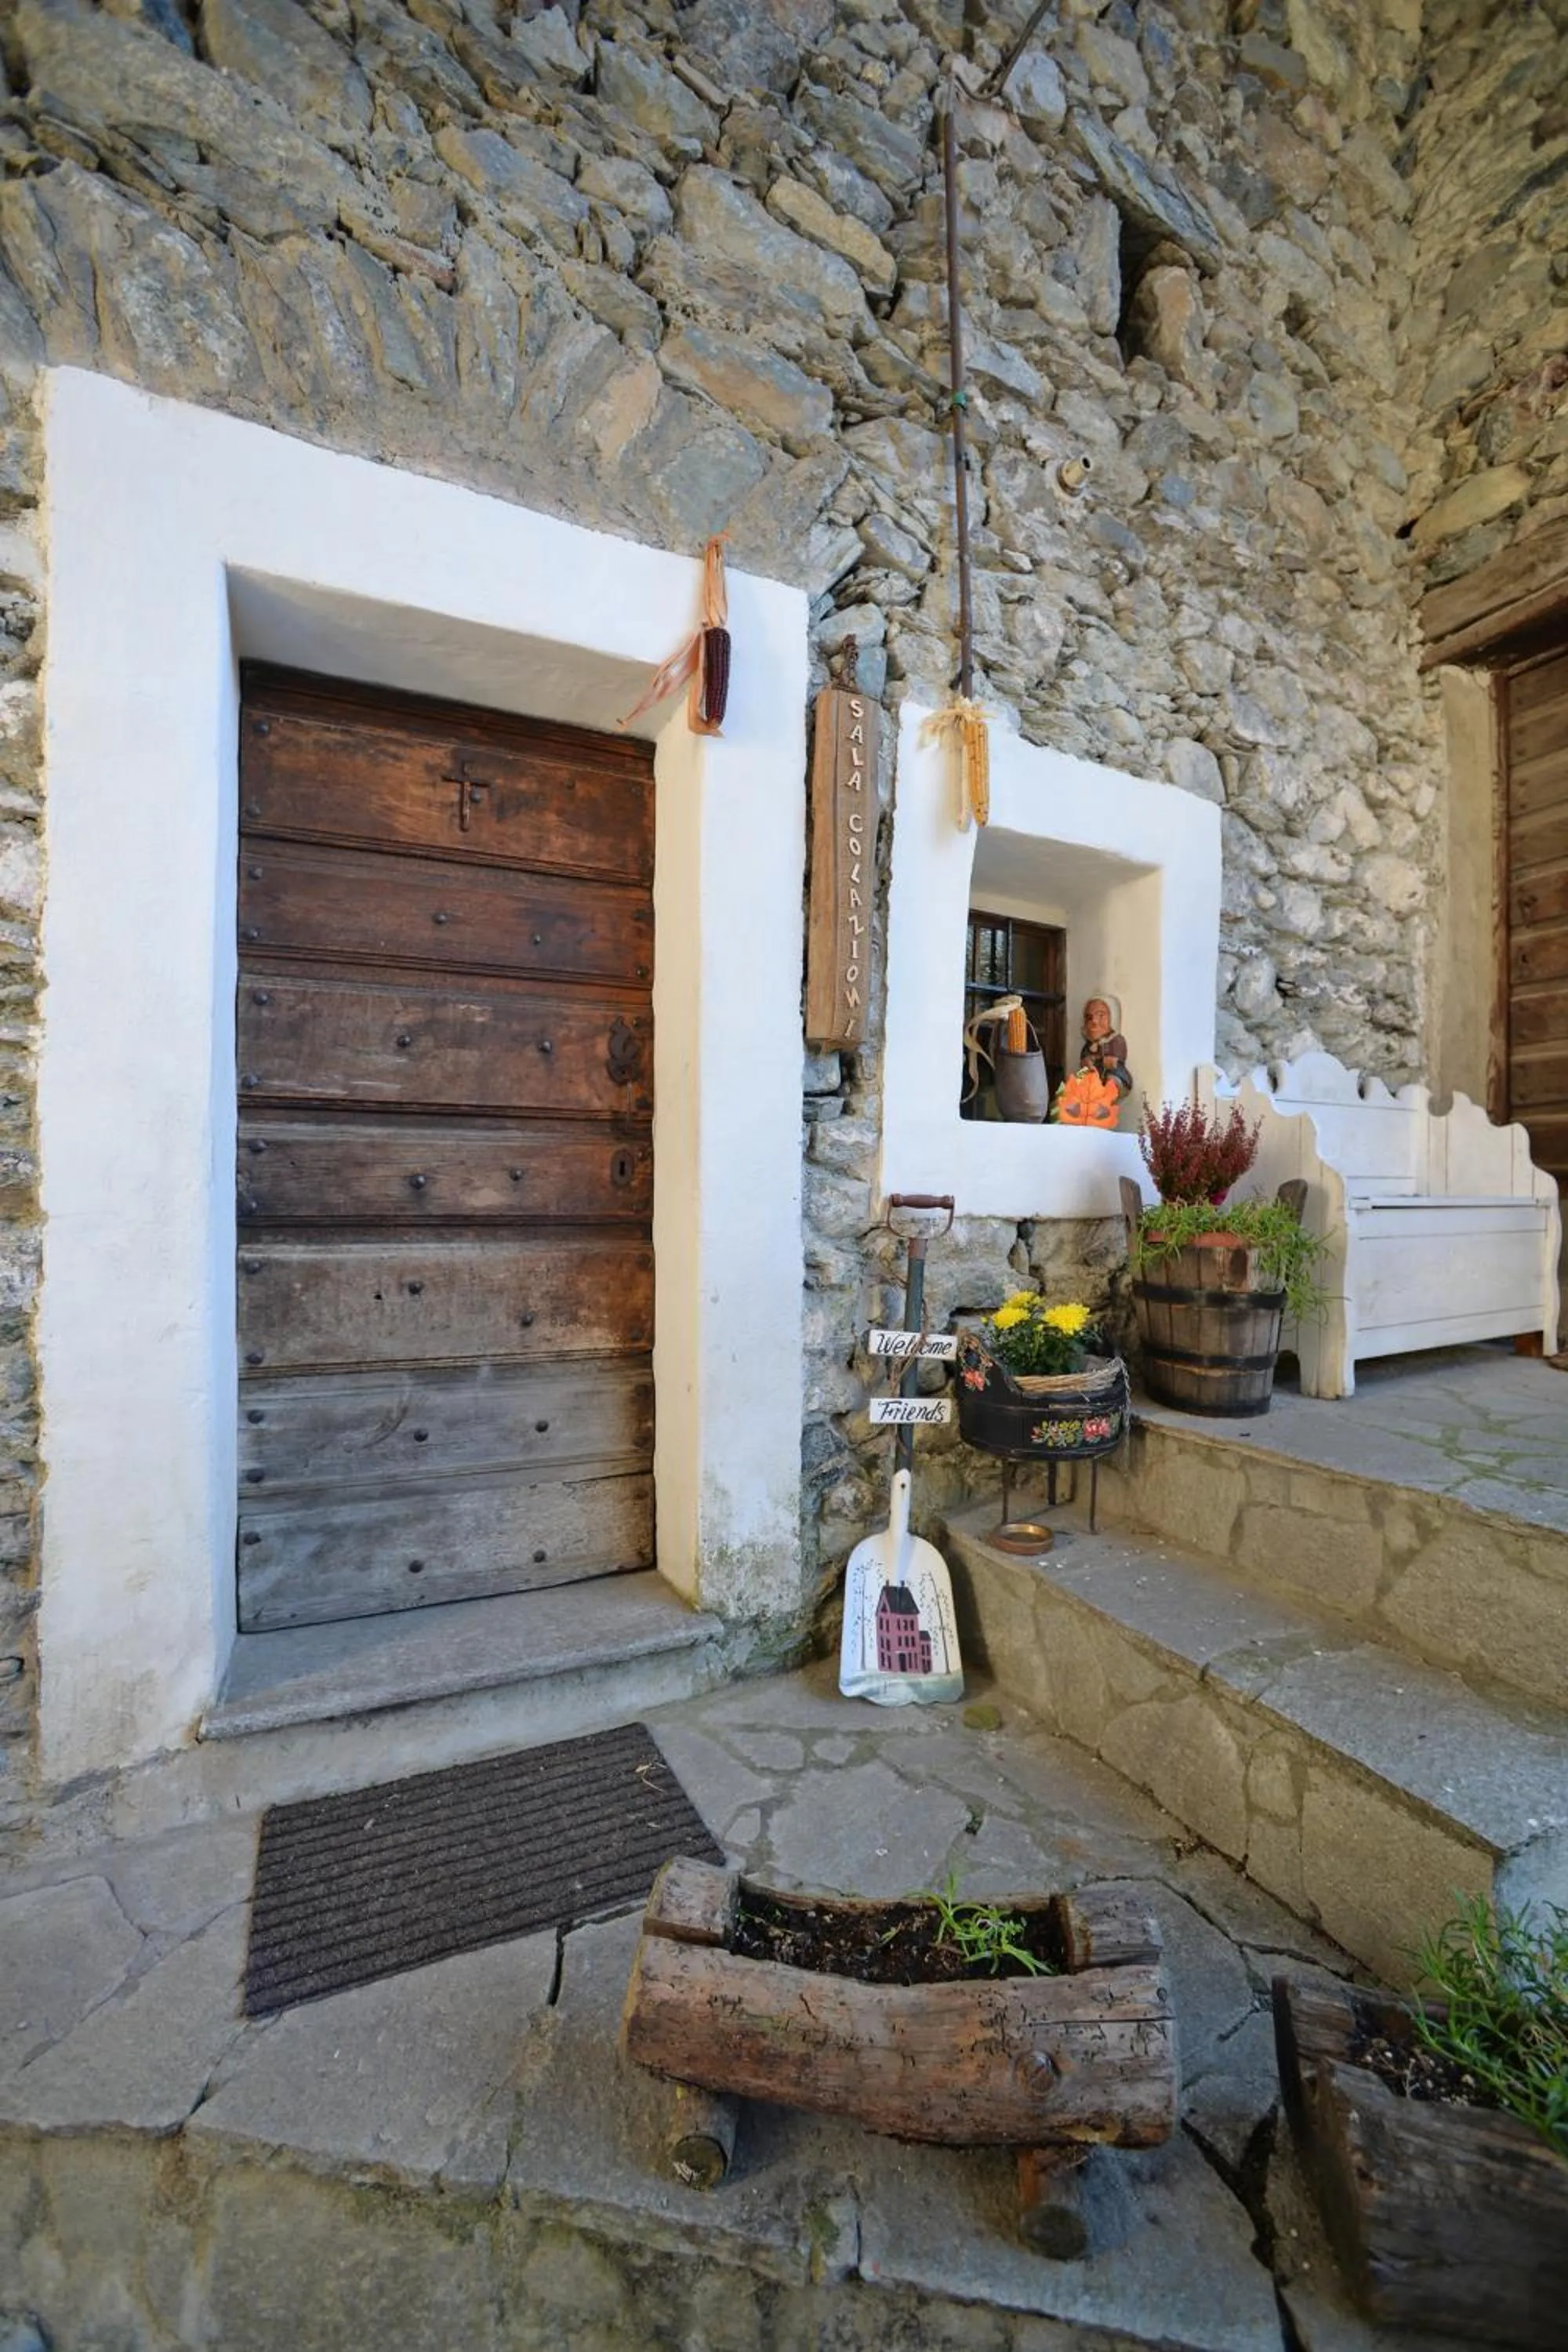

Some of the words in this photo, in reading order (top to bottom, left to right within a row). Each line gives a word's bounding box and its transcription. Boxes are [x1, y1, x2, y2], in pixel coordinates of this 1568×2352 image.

[846, 699, 864, 791] SALA
[844, 814, 865, 1038] COLAZIONI
[877, 1333, 953, 1355] Welome
[878, 1400, 946, 1422] Friends
